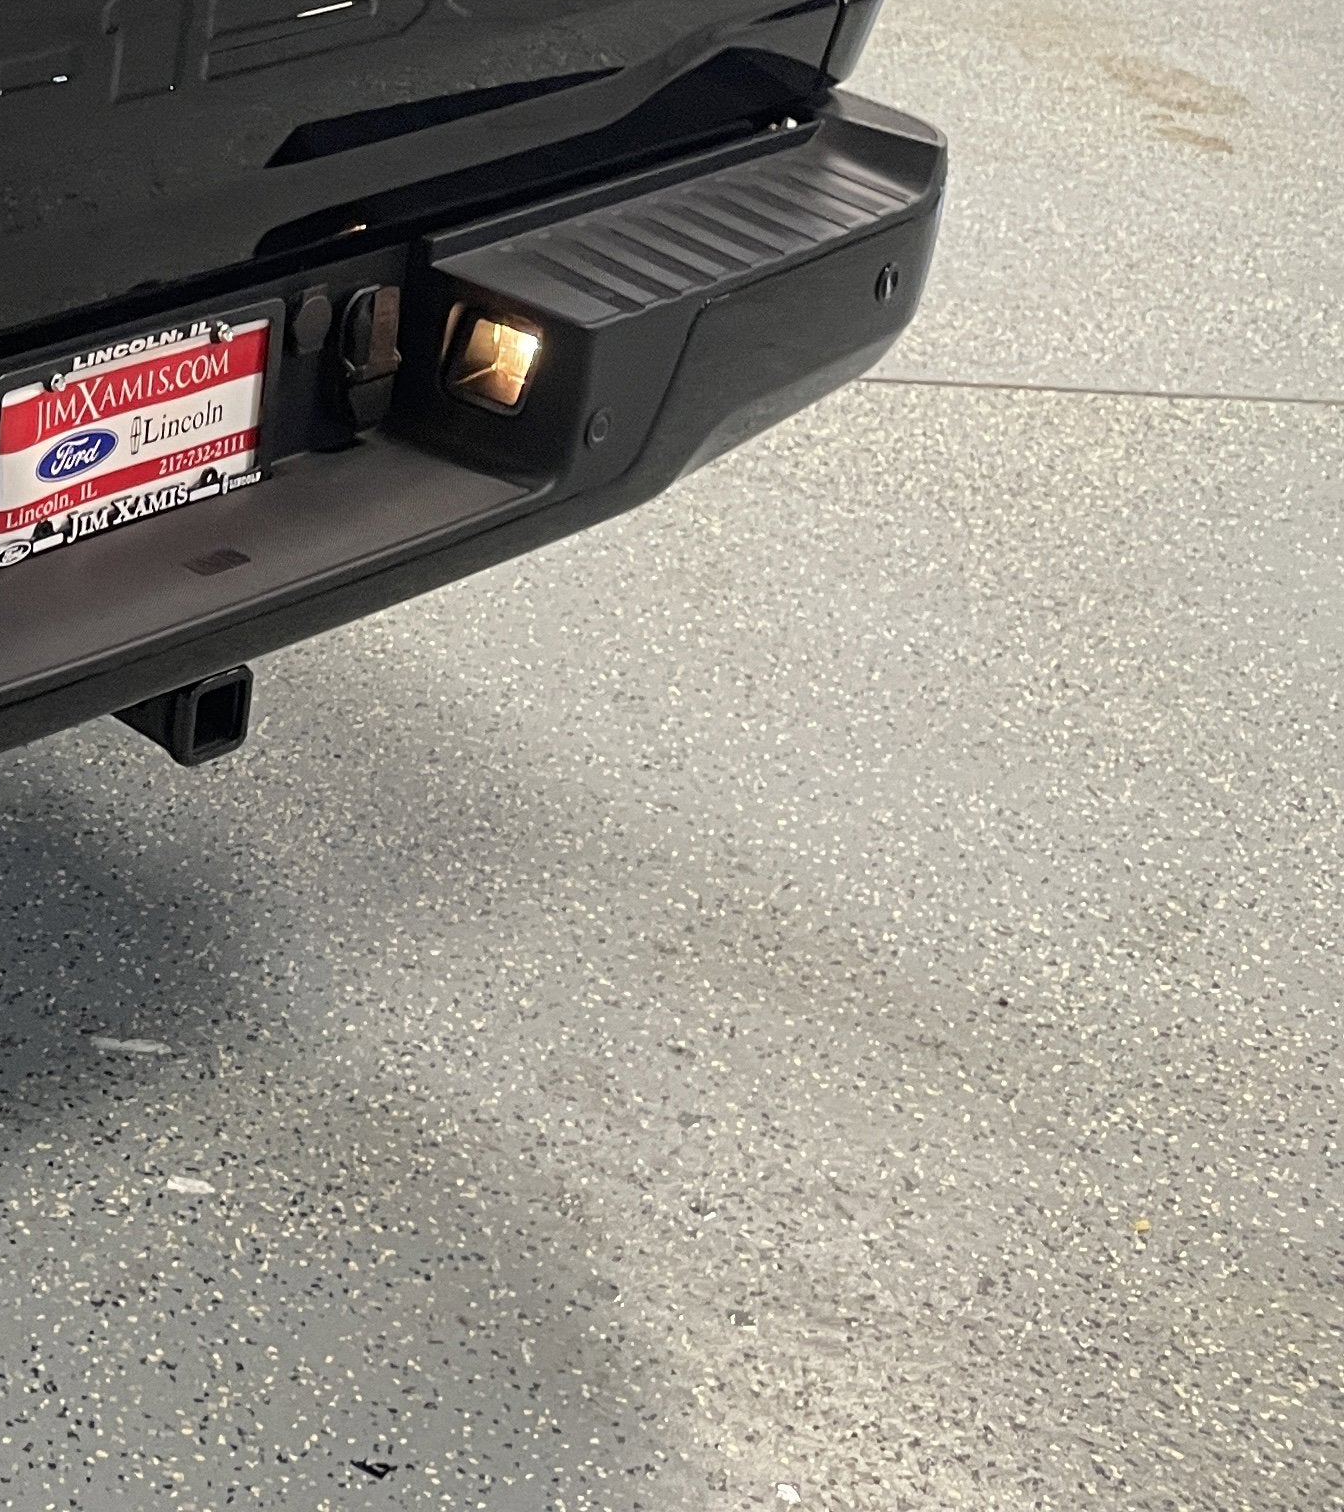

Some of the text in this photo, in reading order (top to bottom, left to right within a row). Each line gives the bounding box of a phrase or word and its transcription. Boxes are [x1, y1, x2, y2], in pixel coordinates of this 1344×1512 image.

[72, 321, 212, 371] LINCOLN, IL
[142, 400, 223, 445] Lincoln
[50, 436, 100, 476] Ford
[5, 483, 98, 530] Lincoln, IL
[67, 484, 189, 543] JIM XAMIS
